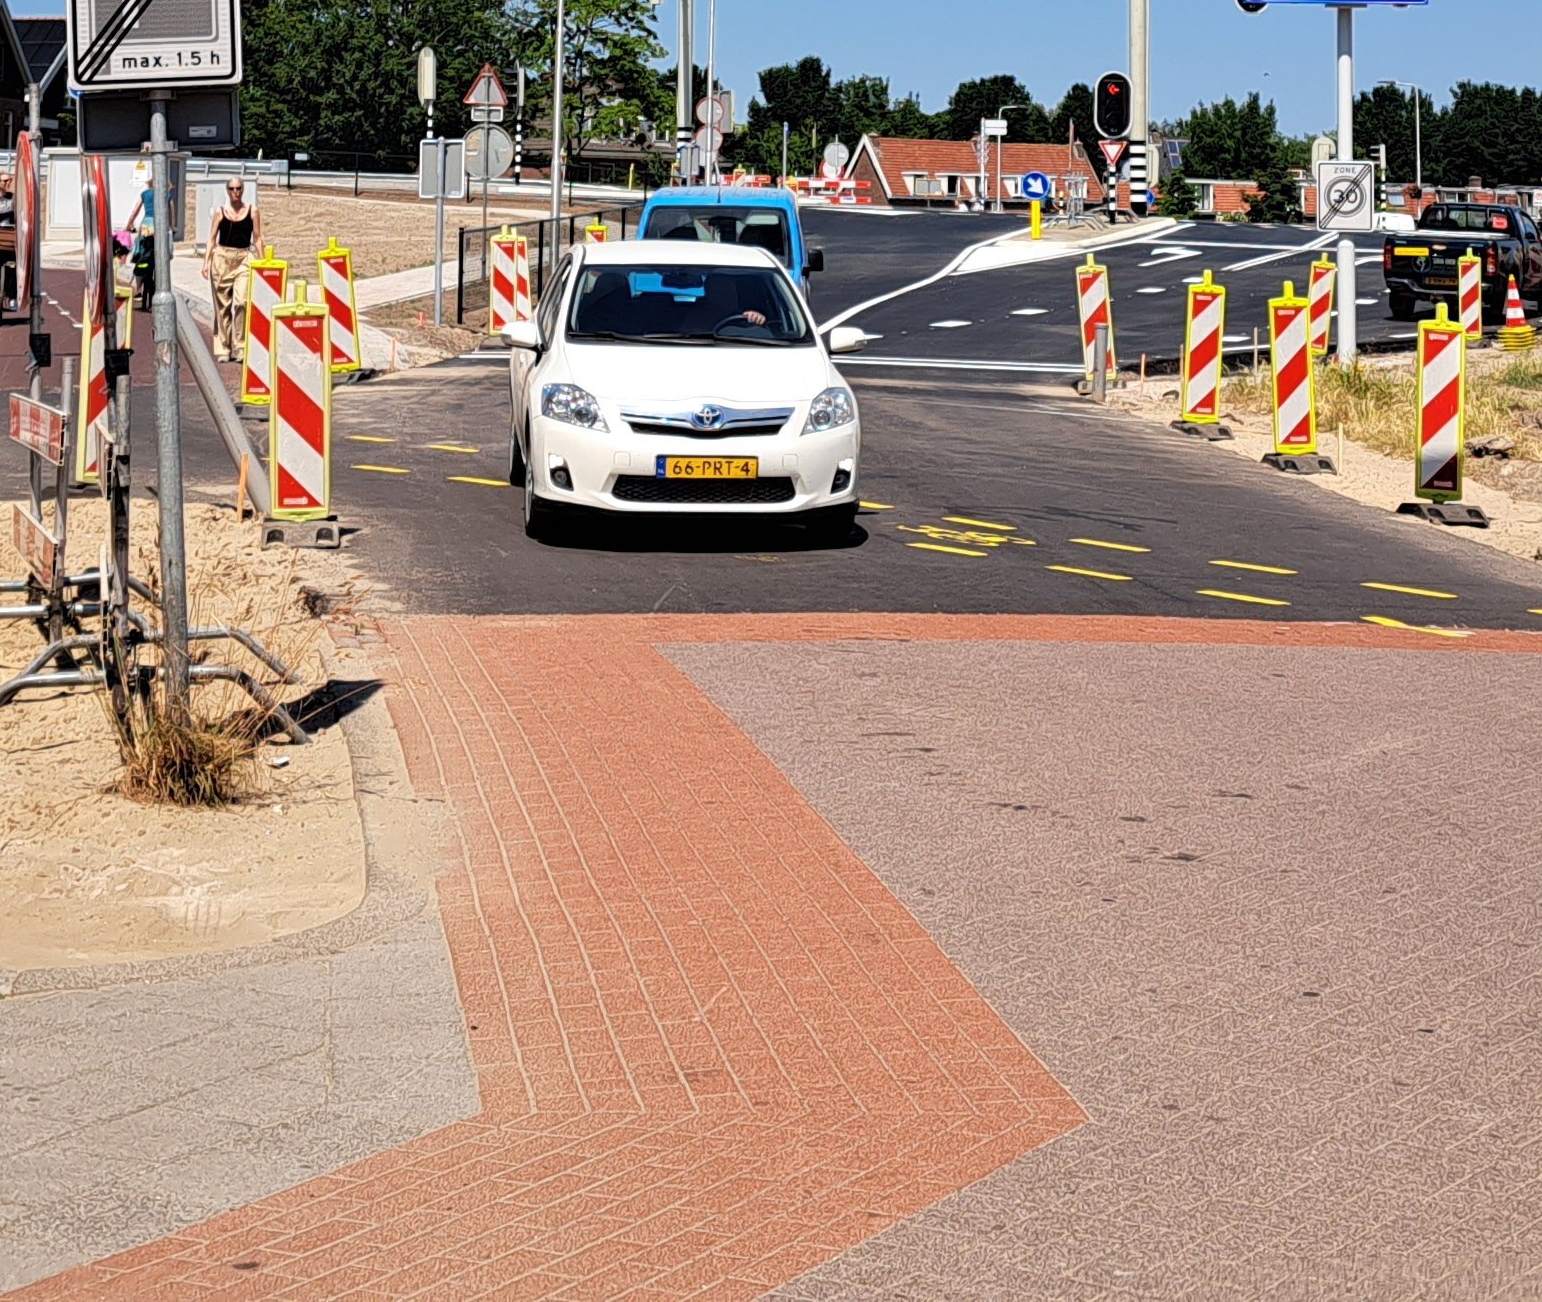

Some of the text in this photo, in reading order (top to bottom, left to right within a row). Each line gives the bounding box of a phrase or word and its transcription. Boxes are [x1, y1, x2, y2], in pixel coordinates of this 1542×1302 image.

[121, 50, 221, 69] max. 1.5 h
[1332, 189, 1358, 204] 30
[672, 460, 751, 476] 66-PRT-4
